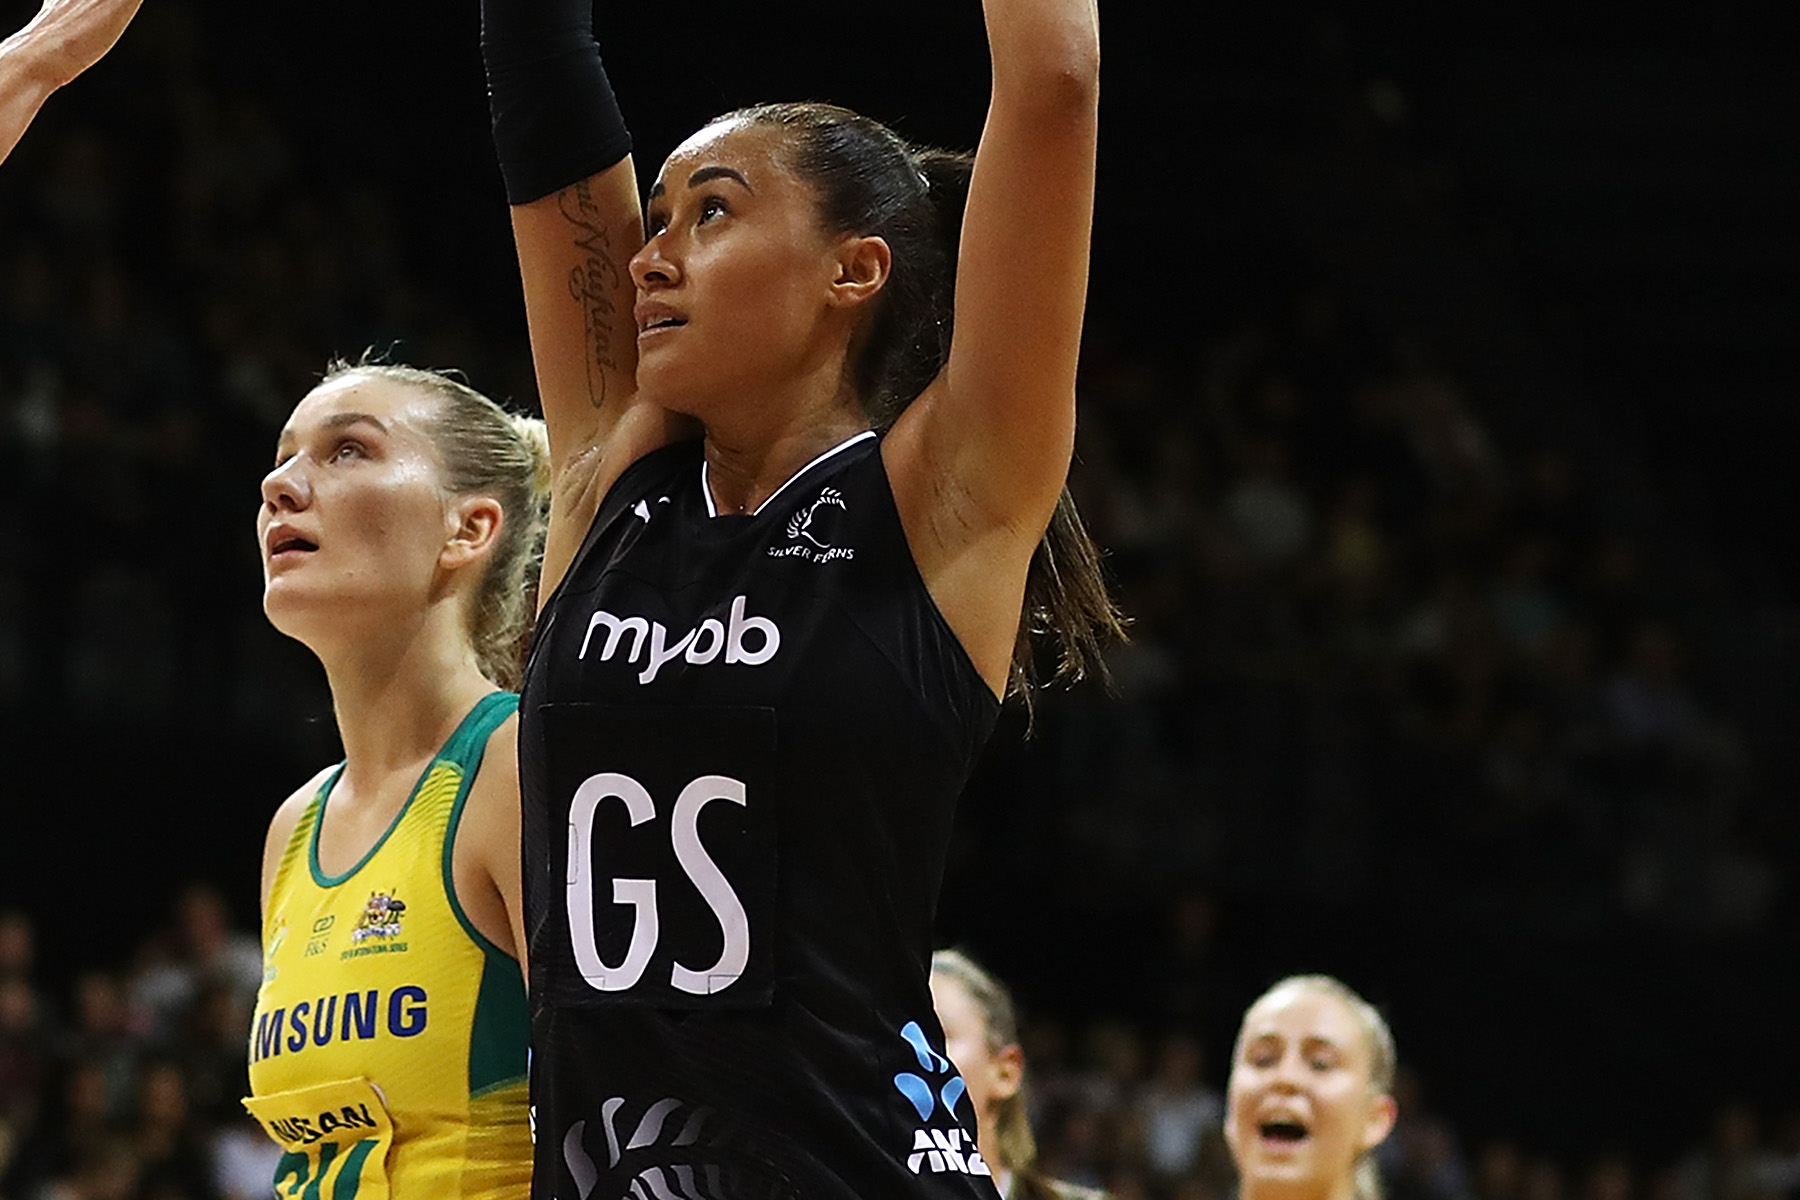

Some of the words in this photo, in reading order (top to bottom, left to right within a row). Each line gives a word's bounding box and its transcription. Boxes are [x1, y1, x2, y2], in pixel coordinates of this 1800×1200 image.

[767, 546, 811, 559] SILVER
[813, 548, 855, 564] FERNS
[579, 596, 780, 684] myob
[566, 772, 750, 995] GS
